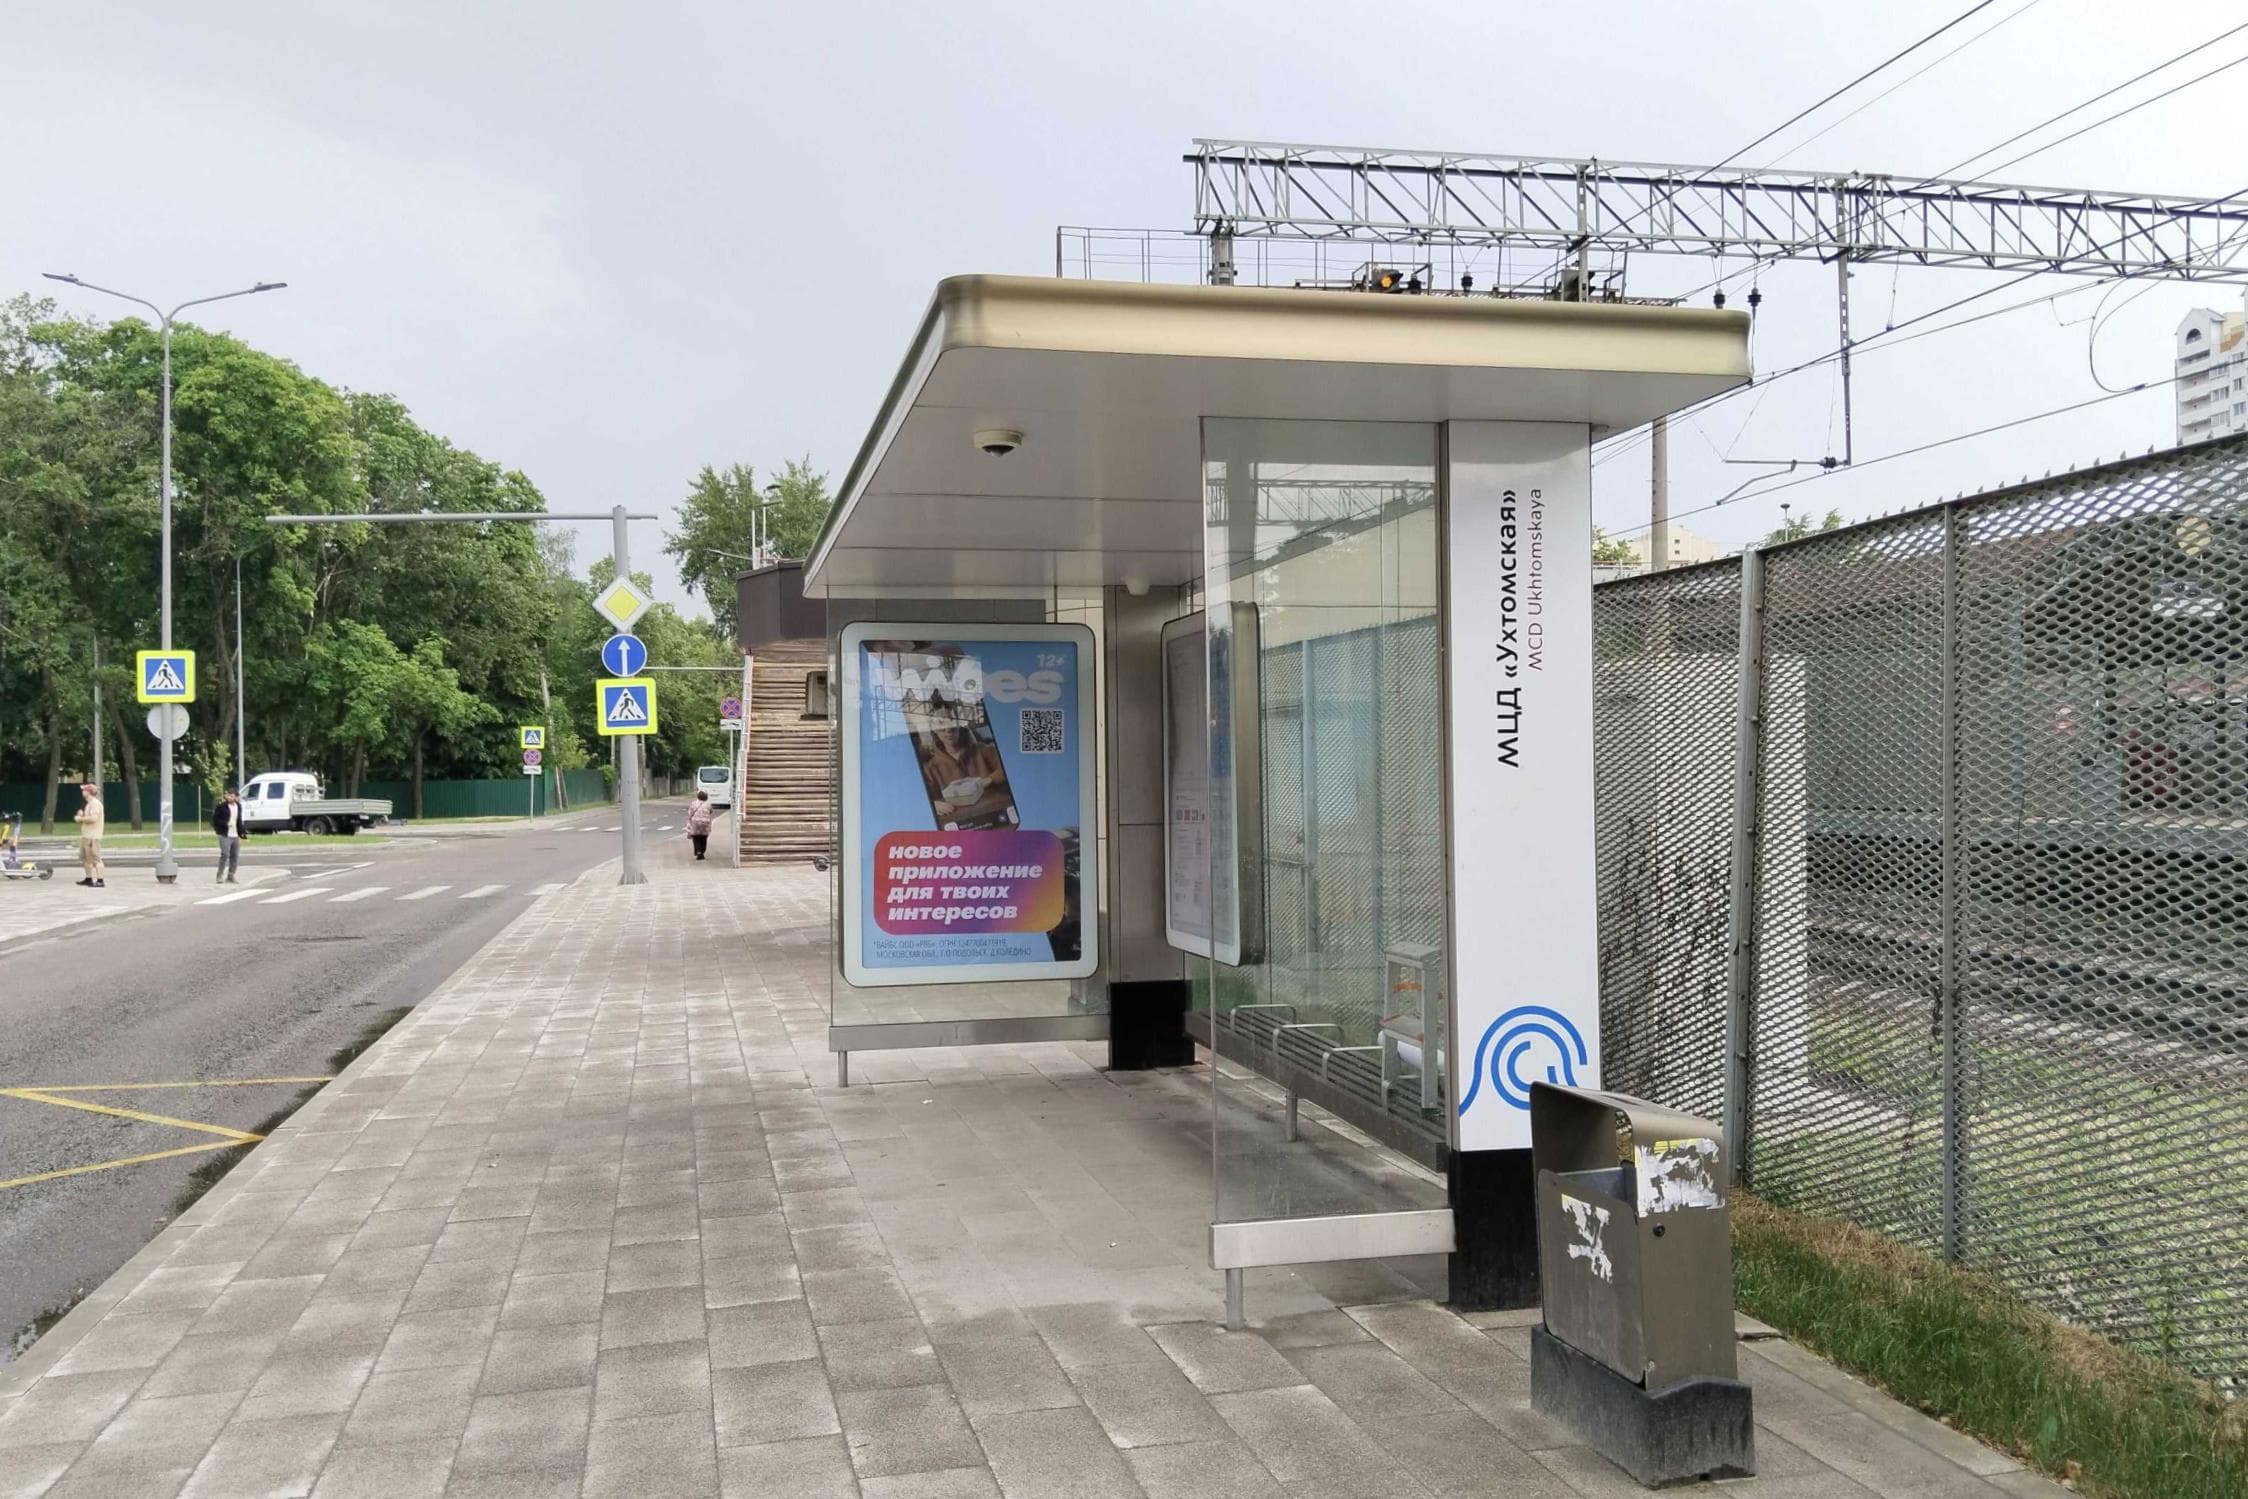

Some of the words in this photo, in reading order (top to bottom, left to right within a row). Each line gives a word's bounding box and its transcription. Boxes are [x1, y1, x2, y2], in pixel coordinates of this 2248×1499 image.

[1527, 488, 1545, 616] Ukhtomskaya
[1496, 488, 1519, 678] «Ухтомская»
[1527, 622, 1543, 671] MCD
[1036, 653, 1066, 668] 12+
[1496, 687, 1522, 768] МЦД
[888, 845, 963, 859] новое
[888, 864, 1043, 884] приложение
[887, 886, 934, 903] для
[940, 885, 1010, 899] твоих
[888, 905, 1018, 924] интересов
